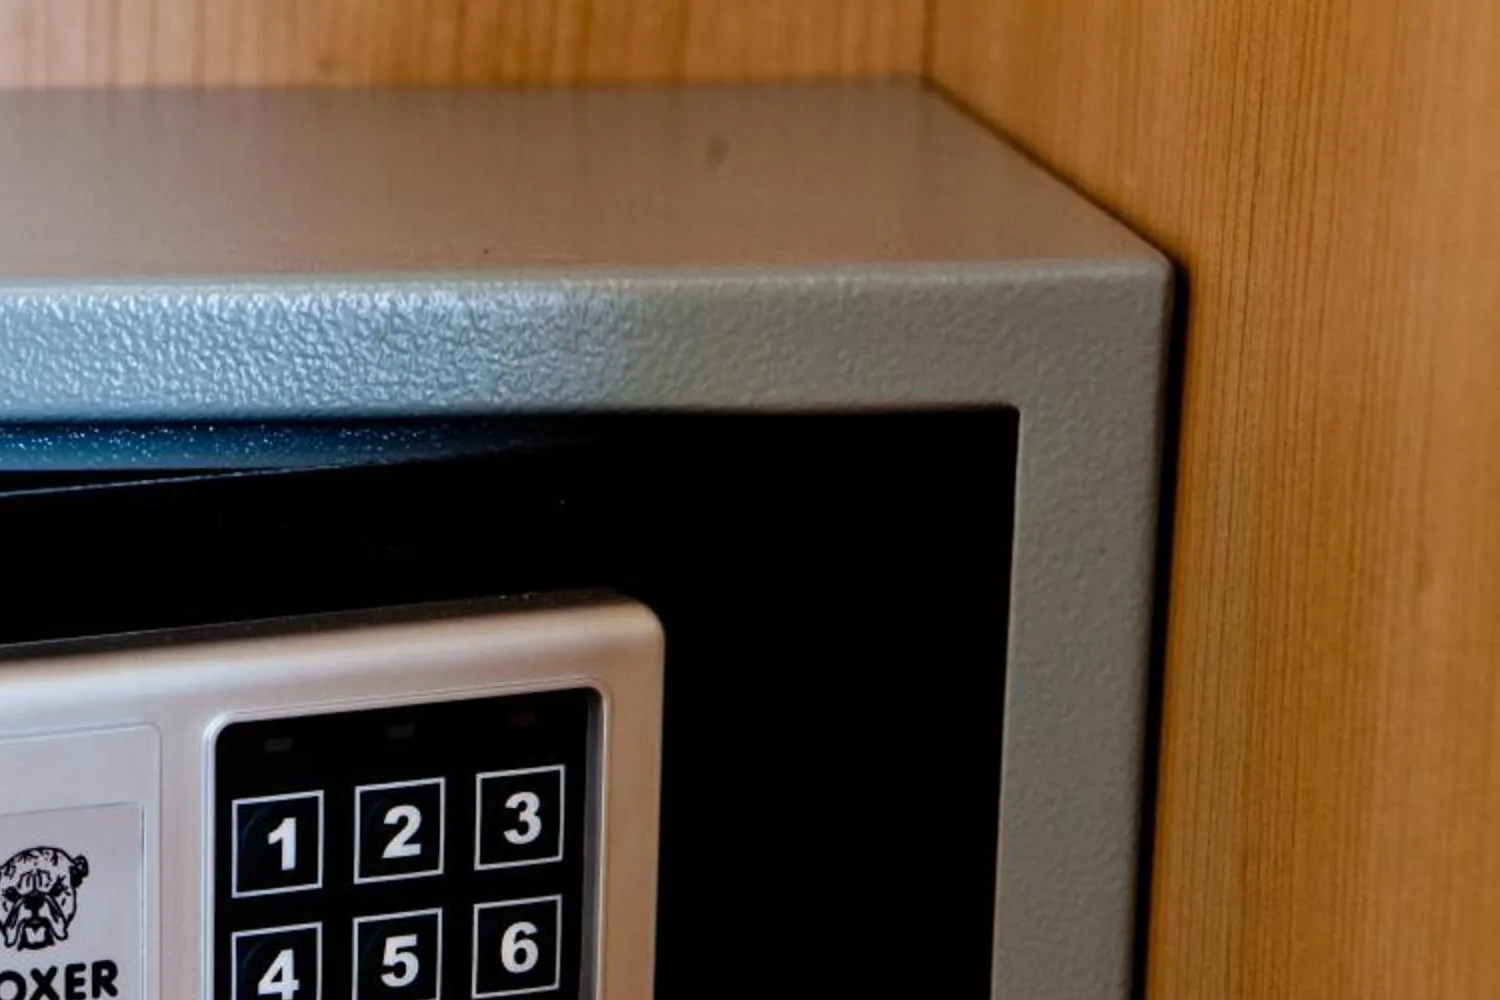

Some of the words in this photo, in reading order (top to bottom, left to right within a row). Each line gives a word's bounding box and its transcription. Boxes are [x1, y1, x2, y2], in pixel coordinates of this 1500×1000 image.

[268, 817, 297, 871] 1
[382, 805, 422, 859] 2
[503, 791, 542, 845] 3
[381, 934, 419, 987] 5
[501, 921, 539, 973] 6
[257, 949, 299, 1000] 4
